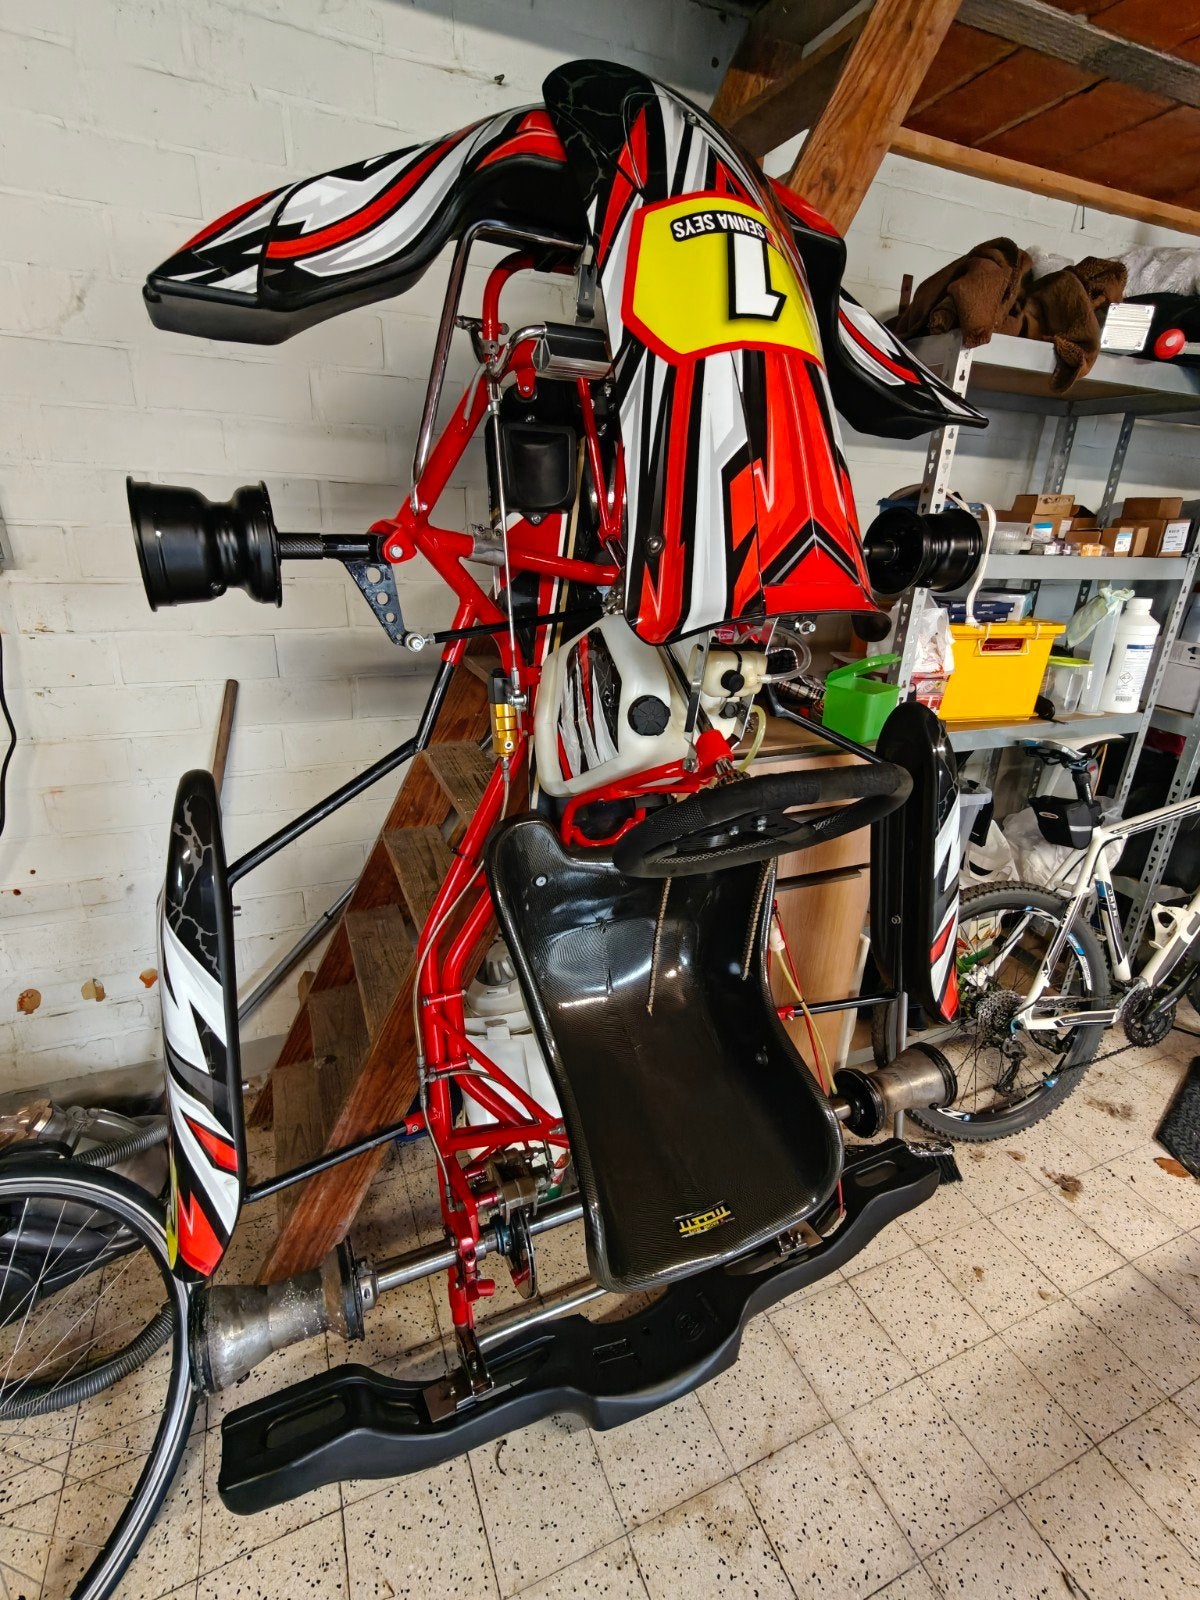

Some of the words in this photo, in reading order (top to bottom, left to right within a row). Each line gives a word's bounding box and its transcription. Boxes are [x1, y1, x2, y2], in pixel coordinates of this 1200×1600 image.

[672, 213, 716, 239] SEYS
[716, 213, 766, 239] SENNA
[728, 232, 787, 322] 1
